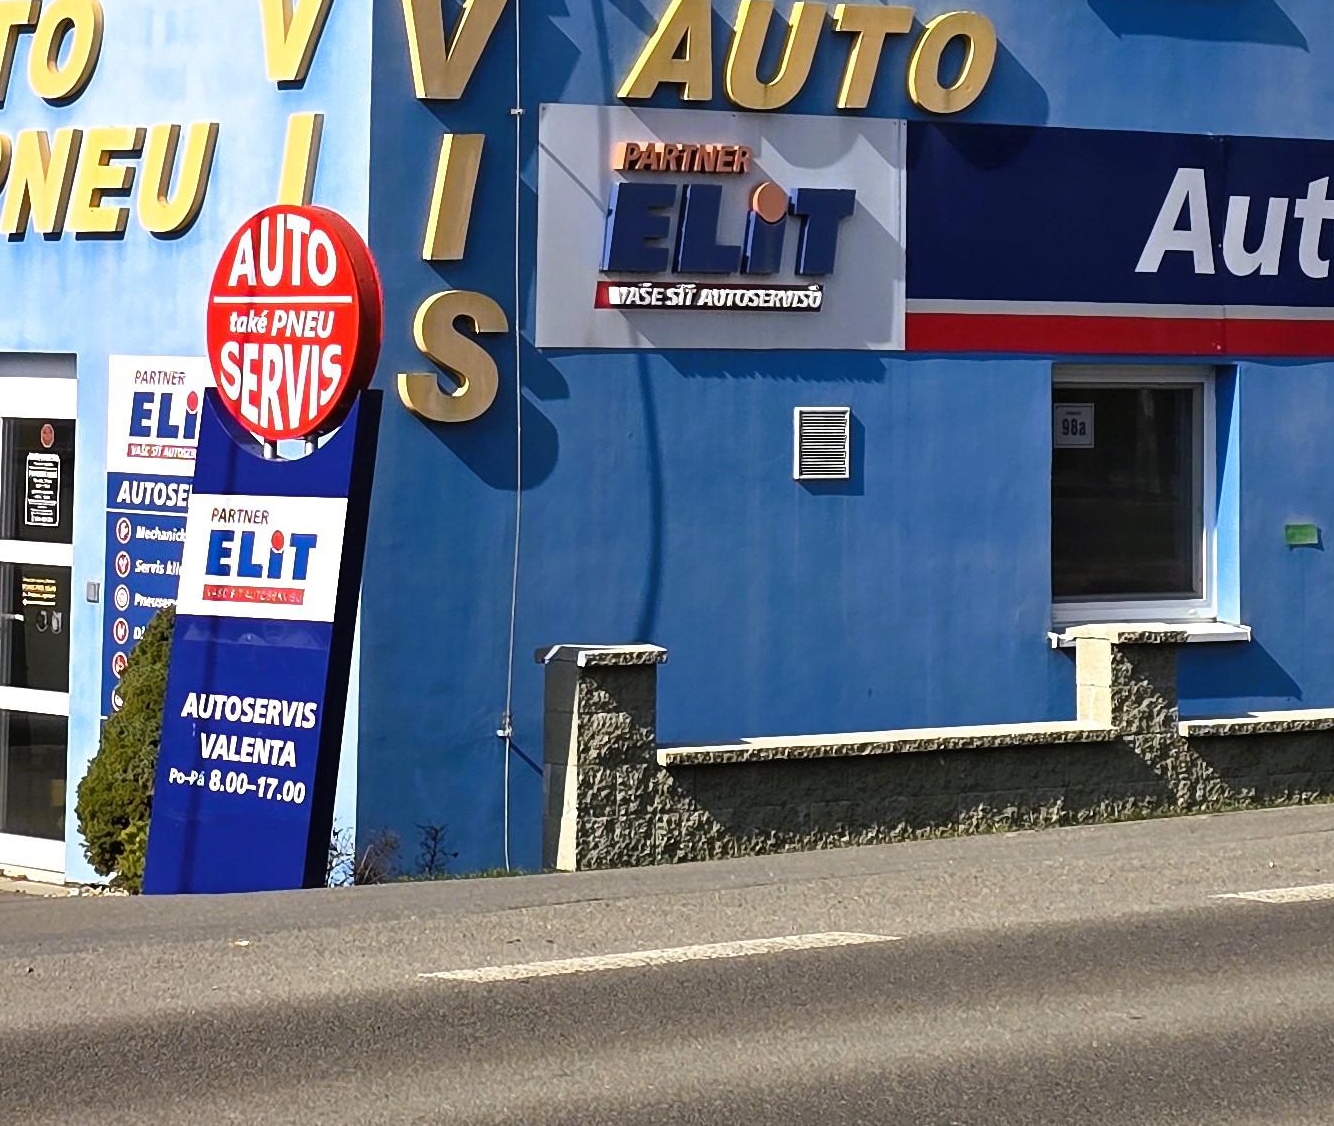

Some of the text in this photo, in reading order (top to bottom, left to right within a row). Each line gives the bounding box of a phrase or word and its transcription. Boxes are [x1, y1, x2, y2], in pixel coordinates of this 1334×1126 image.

[614, 141, 754, 173] PARTNER
[227, 213, 338, 287] AUTO
[229, 309, 335, 338] také PNEU
[134, 370, 186, 385] PARTNER
[220, 340, 343, 431] SERVIS
[1062, 417, 1087, 436] 98a
[211, 507, 270, 525] PARTNER
[181, 692, 317, 728] AUTOSERVIS
[200, 732, 297, 768] VALENTA
[208, 769, 306, 804] 8.00-17.00
